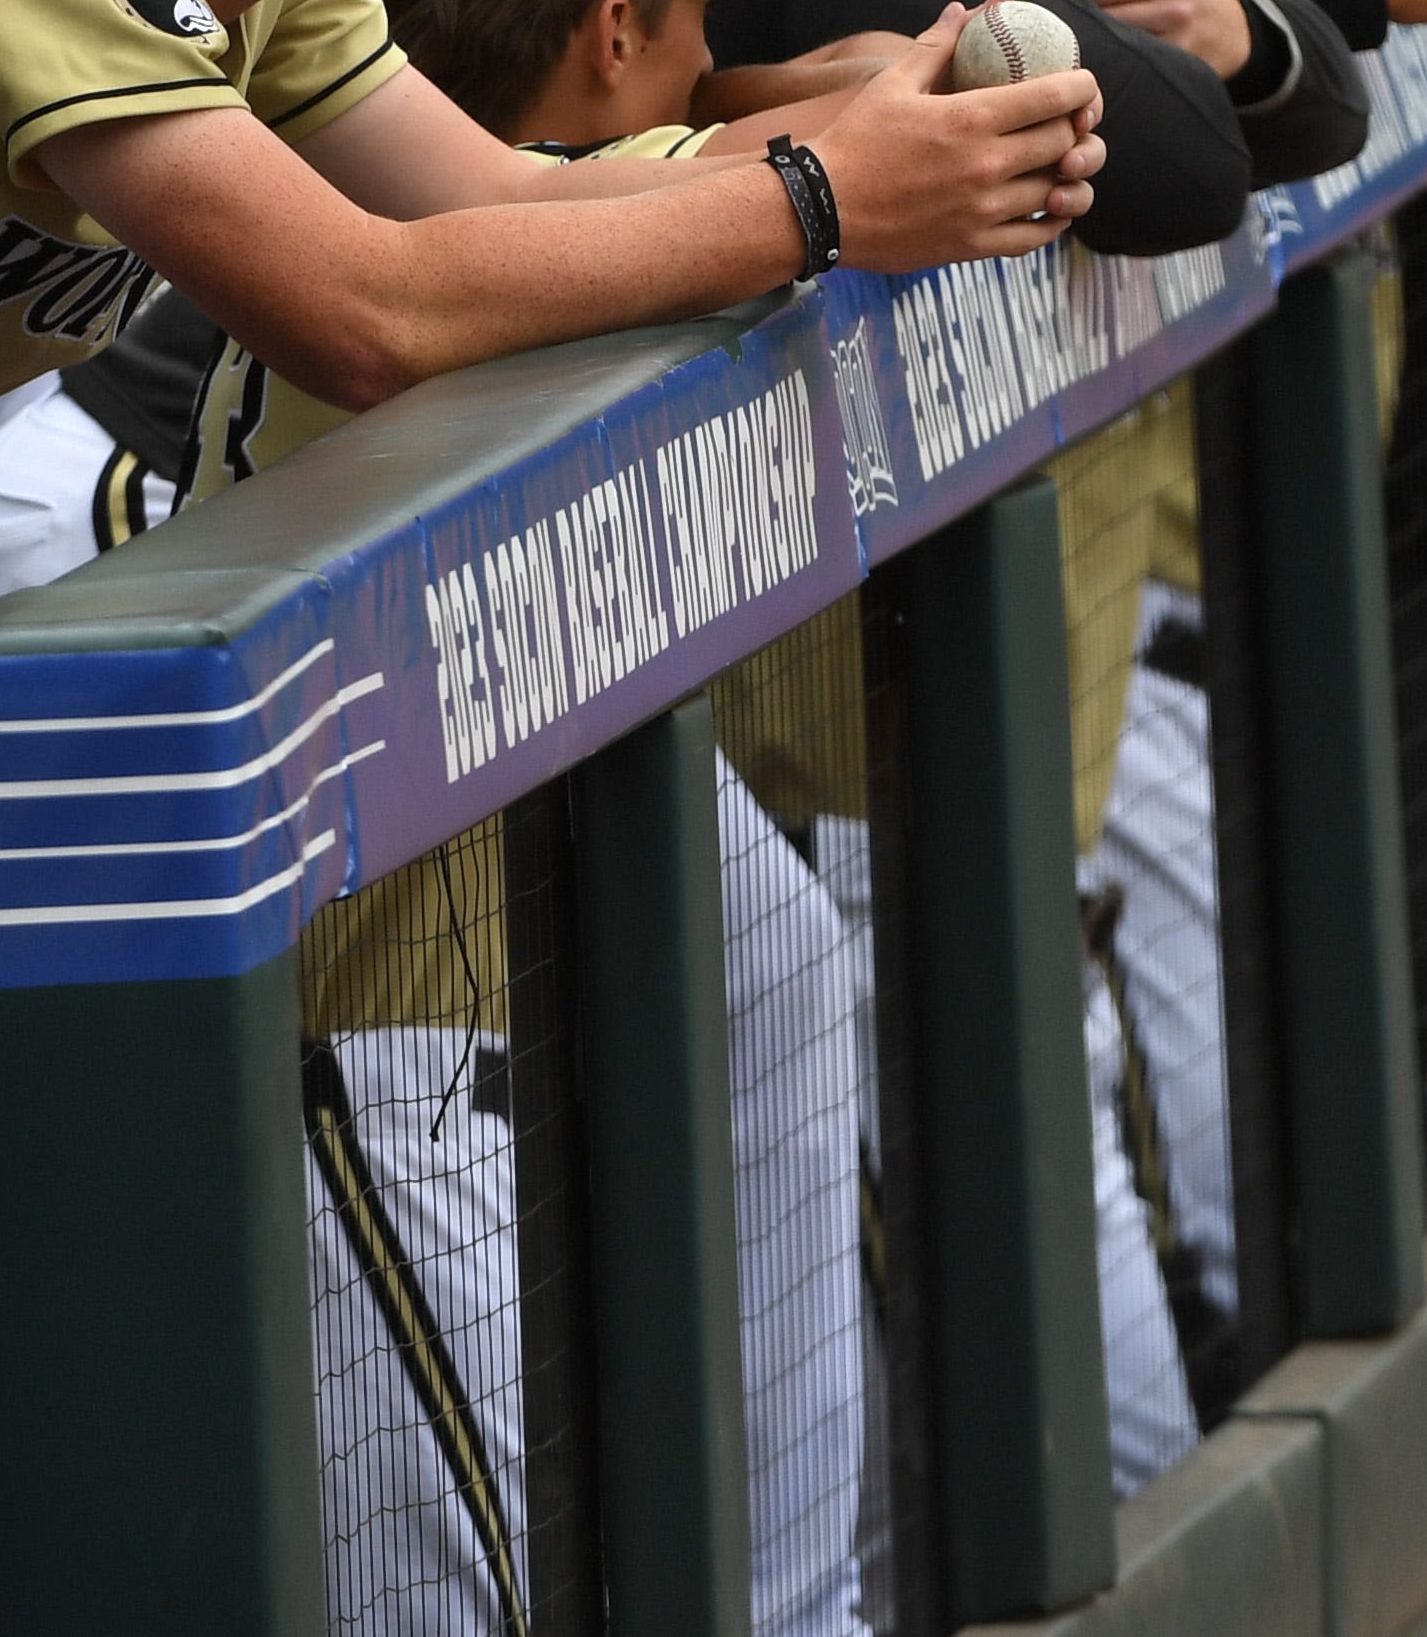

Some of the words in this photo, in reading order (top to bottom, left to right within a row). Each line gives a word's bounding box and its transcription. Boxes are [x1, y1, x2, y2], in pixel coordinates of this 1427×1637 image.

[892, 277, 964, 482] 2023
[938, 257, 1024, 449] SOCON
[425, 562, 497, 784] 2023
[484, 517, 570, 749] SOCON
[555, 457, 670, 706] BASEBALL
[656, 367, 820, 640] CHAMPIONSHIP
